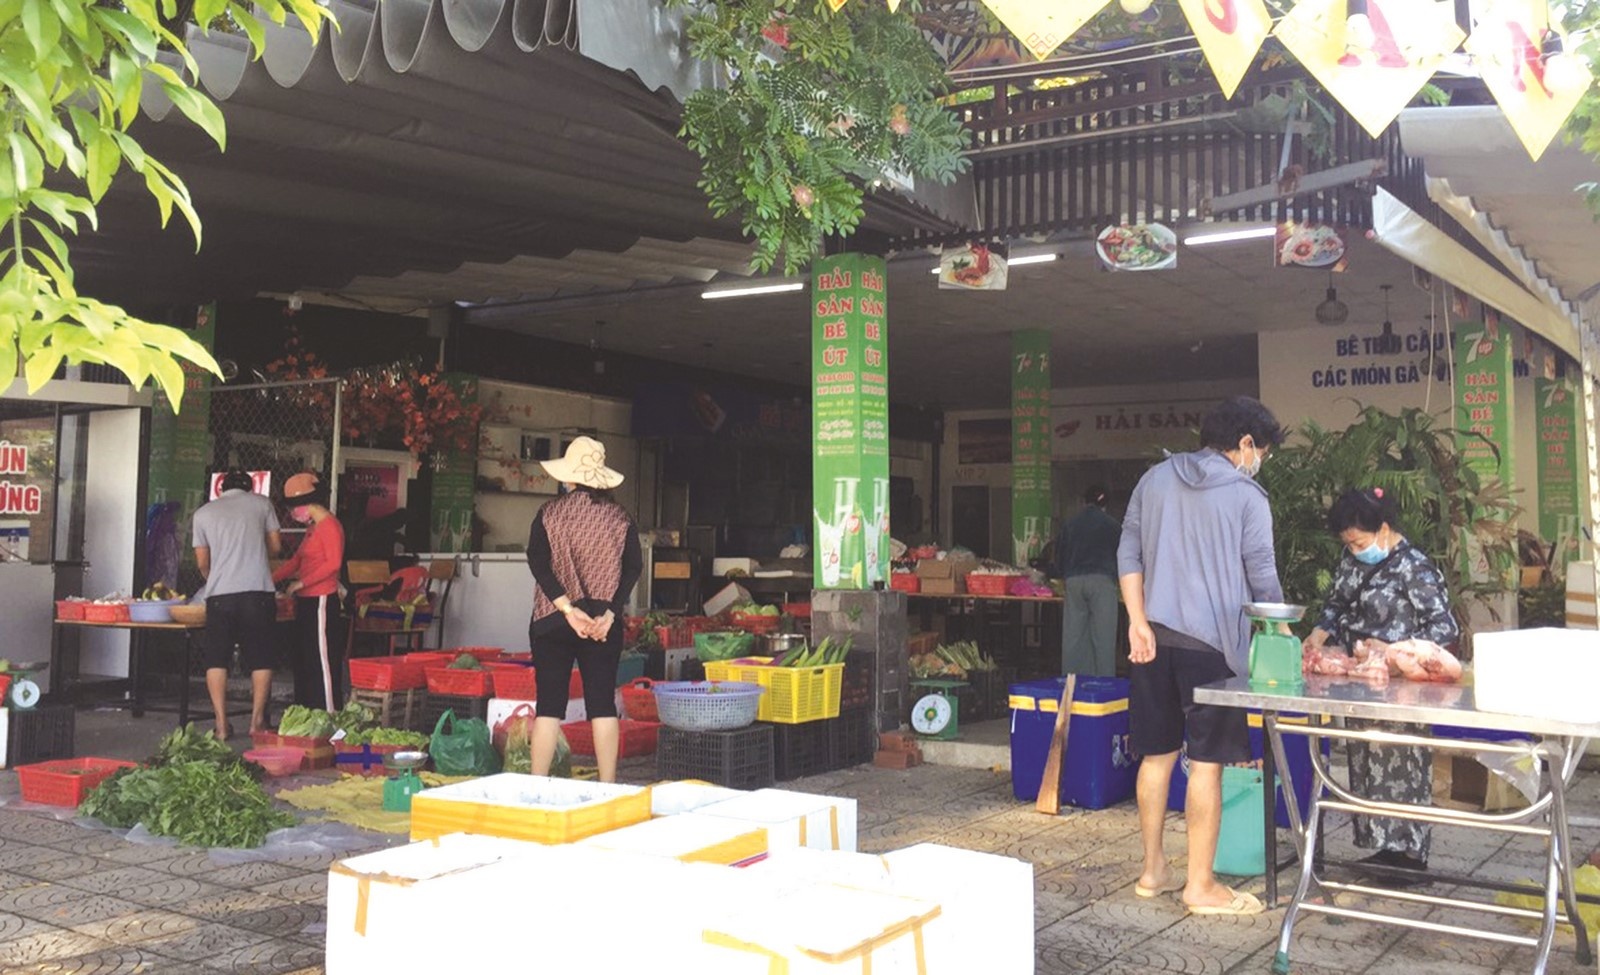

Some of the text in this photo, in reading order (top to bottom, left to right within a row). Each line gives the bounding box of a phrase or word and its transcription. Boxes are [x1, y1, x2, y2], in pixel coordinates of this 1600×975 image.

[818, 267, 852, 291] HẢI
[862, 268, 883, 292] HẢI
[817, 294, 853, 317] SẢN
[861, 294, 884, 318] SẢN
[824, 319, 847, 339] BÉ
[865, 321, 880, 341] BÉ
[865, 345, 881, 367] ÚT
[1336, 334, 1359, 356] BÊ
[823, 346, 848, 367] ÚT
[1312, 365, 1347, 387] CÁC
[1351, 363, 1391, 385] MÓN
[1395, 361, 1420, 384] GÀ
[1465, 369, 1498, 386] HẢI
[1464, 388, 1499, 404] SẢN
[1095, 405, 1200, 429] HẢI SẢN
[1470, 406, 1493, 421] BÉ
